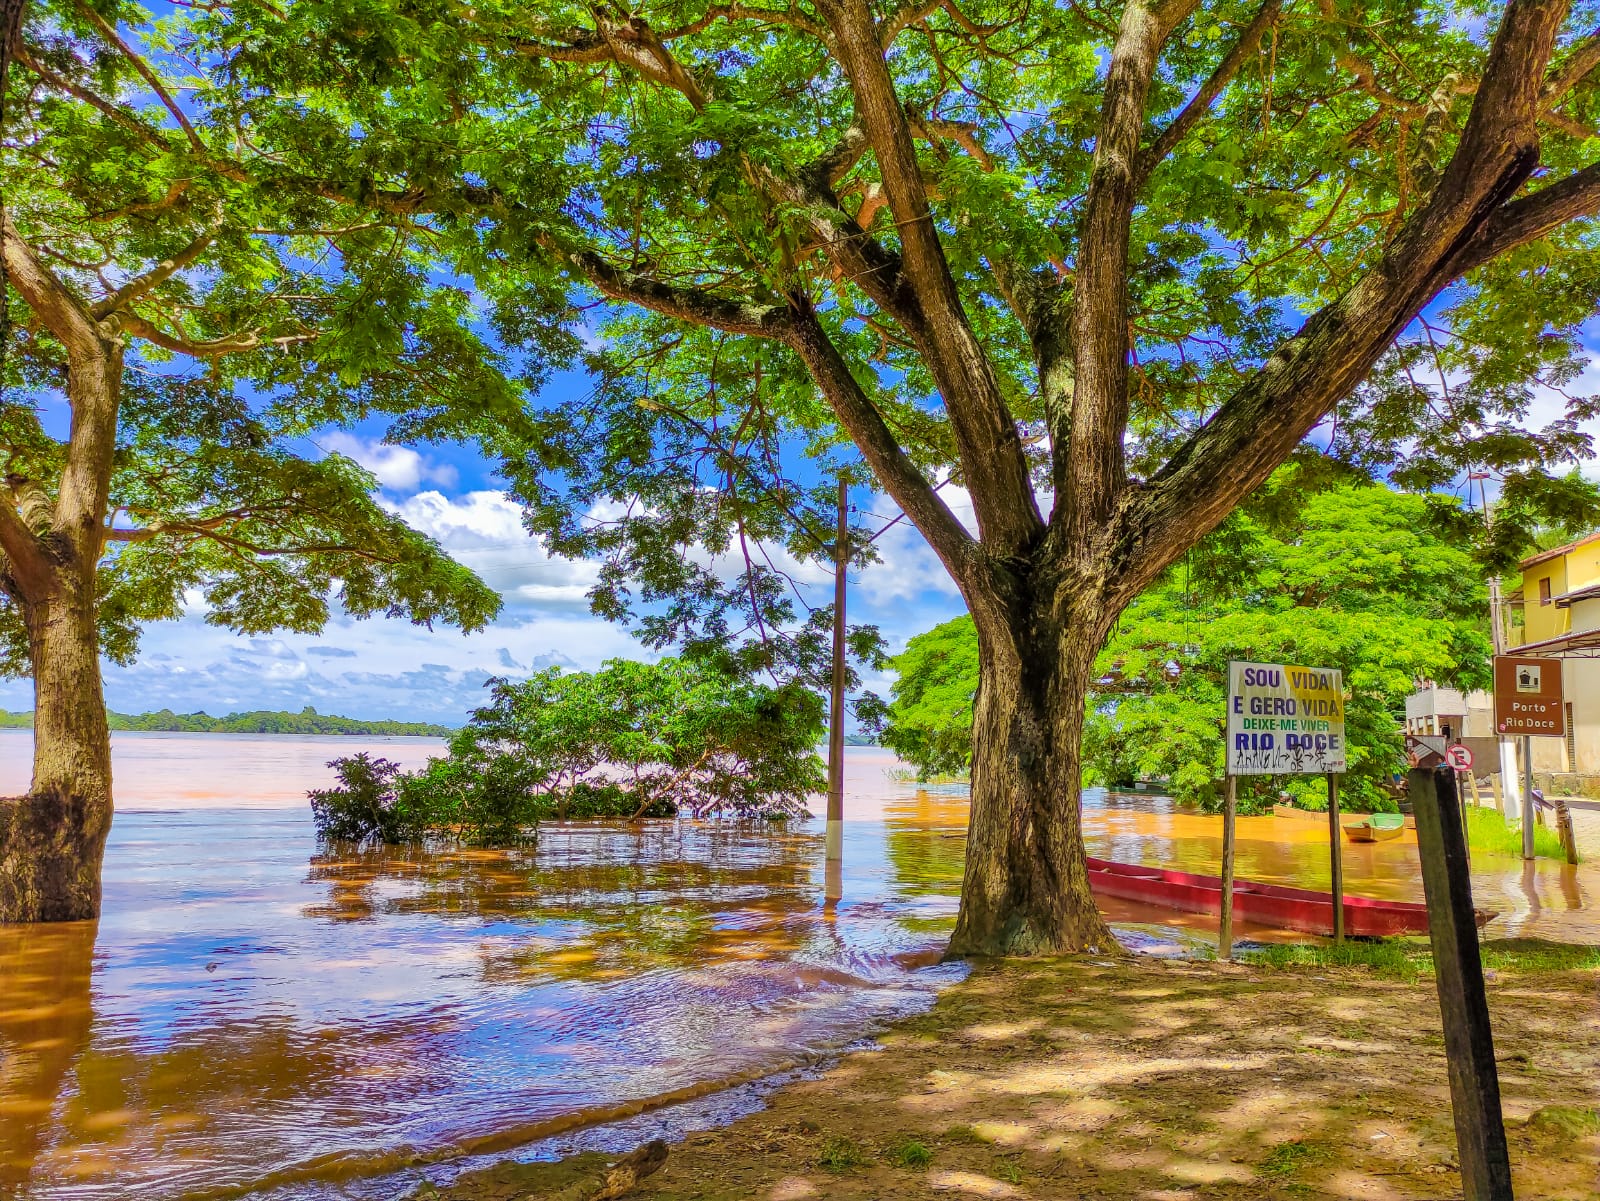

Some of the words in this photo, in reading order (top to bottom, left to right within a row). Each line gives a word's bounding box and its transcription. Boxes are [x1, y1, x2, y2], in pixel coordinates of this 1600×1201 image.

[1244, 668, 1280, 687] SOU
[1292, 672, 1329, 691] VIDA
[1233, 696, 1244, 714] E
[1250, 697, 1296, 716] GERO
[1302, 699, 1339, 717] VIDA
[1512, 702, 1546, 713] Porto
[1243, 718, 1297, 731] DEIXE-ME
[1300, 720, 1329, 731] VIVER
[1506, 718, 1524, 727] Rio
[1526, 718, 1555, 728] Doce
[1235, 733, 1274, 750] RIO
[1285, 734, 1339, 750] DOCE
